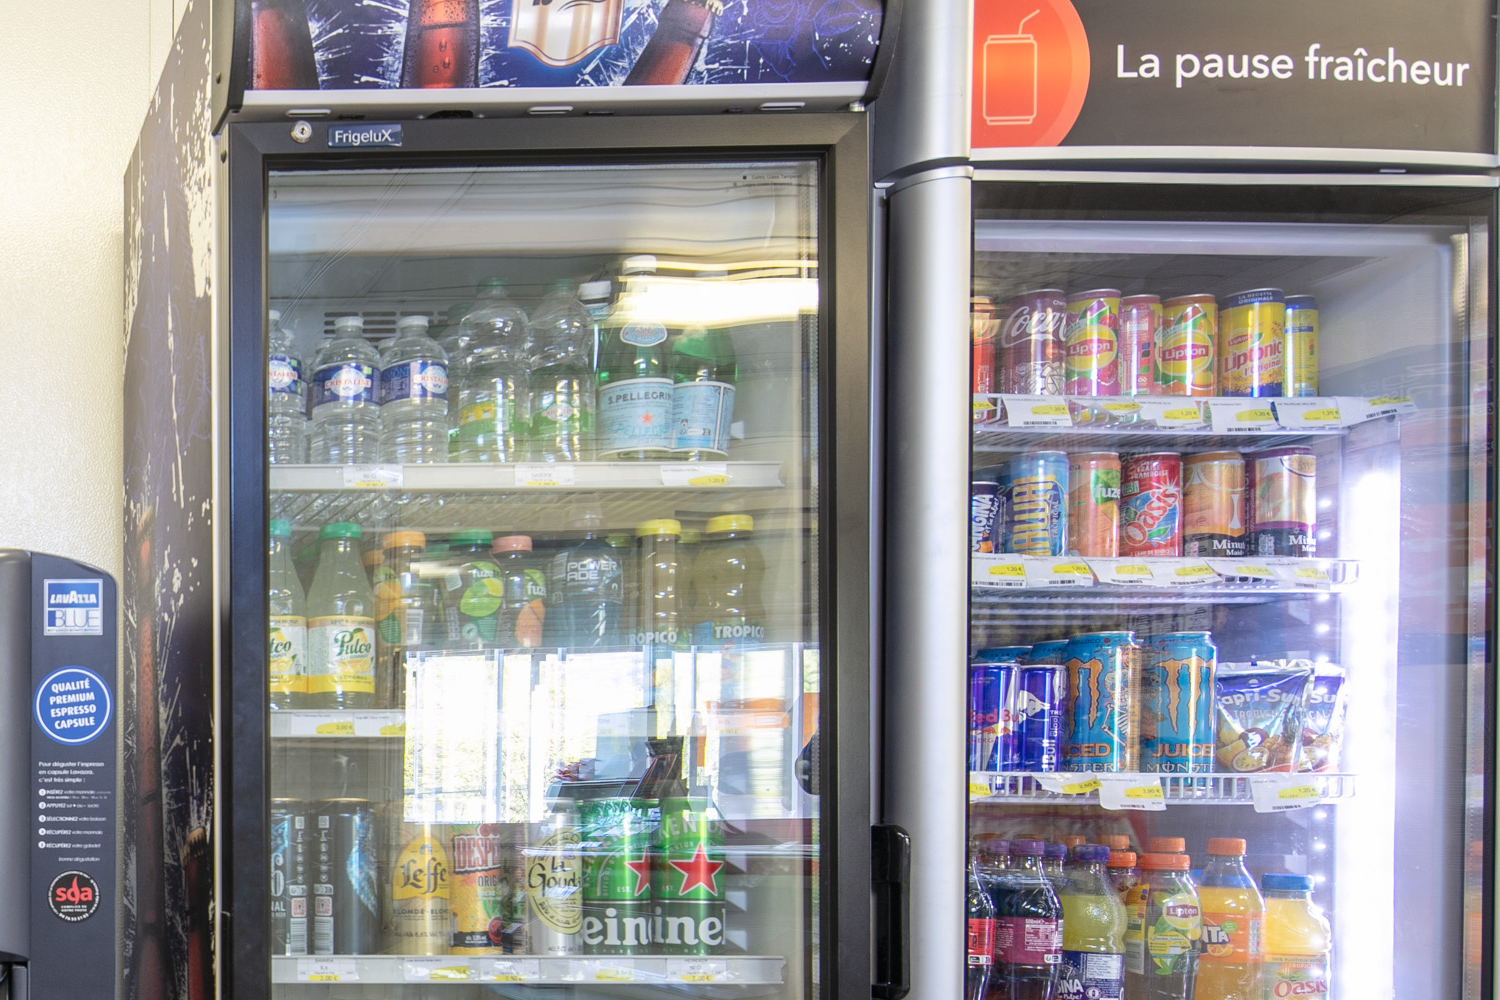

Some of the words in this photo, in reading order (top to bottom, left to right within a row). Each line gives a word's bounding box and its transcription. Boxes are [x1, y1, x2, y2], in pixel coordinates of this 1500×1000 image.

[1116, 44, 1160, 79] La
[1175, 51, 1294, 88] pause
[1305, 43, 1470, 87] fraîcheur
[334, 130, 394, 145] FrigeluX
[608, 391, 673, 405] S.PELLEGRIN
[1124, 486, 1180, 546] Oasis
[472, 568, 494, 579] fuze
[567, 560, 617, 572] POWER
[566, 570, 599, 581] ADE
[50, 590, 97, 604] LAVAZZA
[53, 609, 100, 628] BLUE
[628, 631, 677, 646] ROPICO
[715, 625, 765, 639] TROPICO
[334, 629, 372, 656] Pulco
[51, 678, 90, 693] QUALITÉ
[49, 692, 95, 705] PREMIUM
[50, 704, 97, 717] ESPRESSO
[54, 716, 95, 730] CAPSULE
[1151, 743, 1216, 758] JUICE
[400, 857, 447, 895] Leffe
[55, 875, 93, 905] sda
